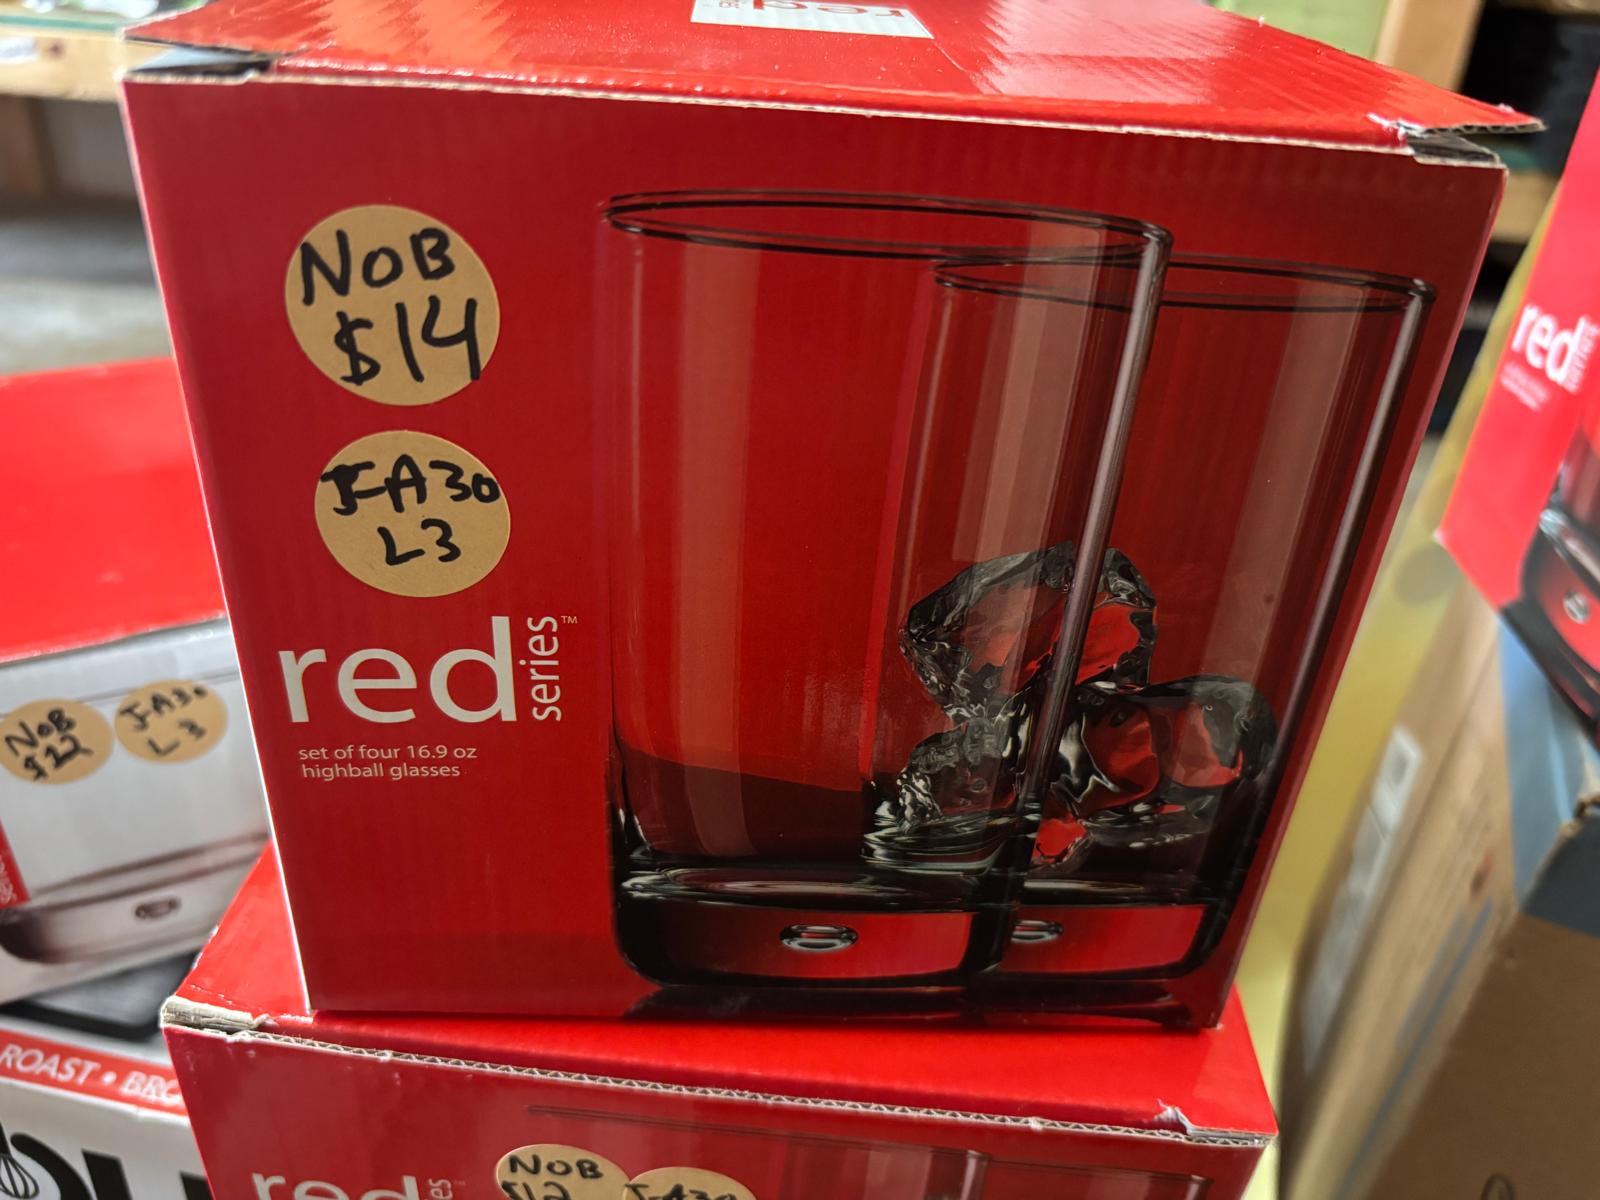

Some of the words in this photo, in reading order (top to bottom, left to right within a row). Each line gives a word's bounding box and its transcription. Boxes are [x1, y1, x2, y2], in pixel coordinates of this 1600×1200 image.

[300, 227, 455, 306] NOB
[334, 295, 482, 385] $14
[1511, 303, 1586, 384] red
[377, 518, 462, 566] L3
[278, 615, 518, 723] red
[519, 616, 562, 722] series
[299, 746, 329, 760] set
[334, 744, 354, 760] of
[358, 744, 401, 760] four
[407, 744, 448, 759] 16.9
[453, 746, 477, 759] oz
[302, 762, 384, 781] highball
[390, 762, 461, 780] glasses
[0, 1043, 101, 1086] ROAST
[507, 1154, 603, 1179] NOB
